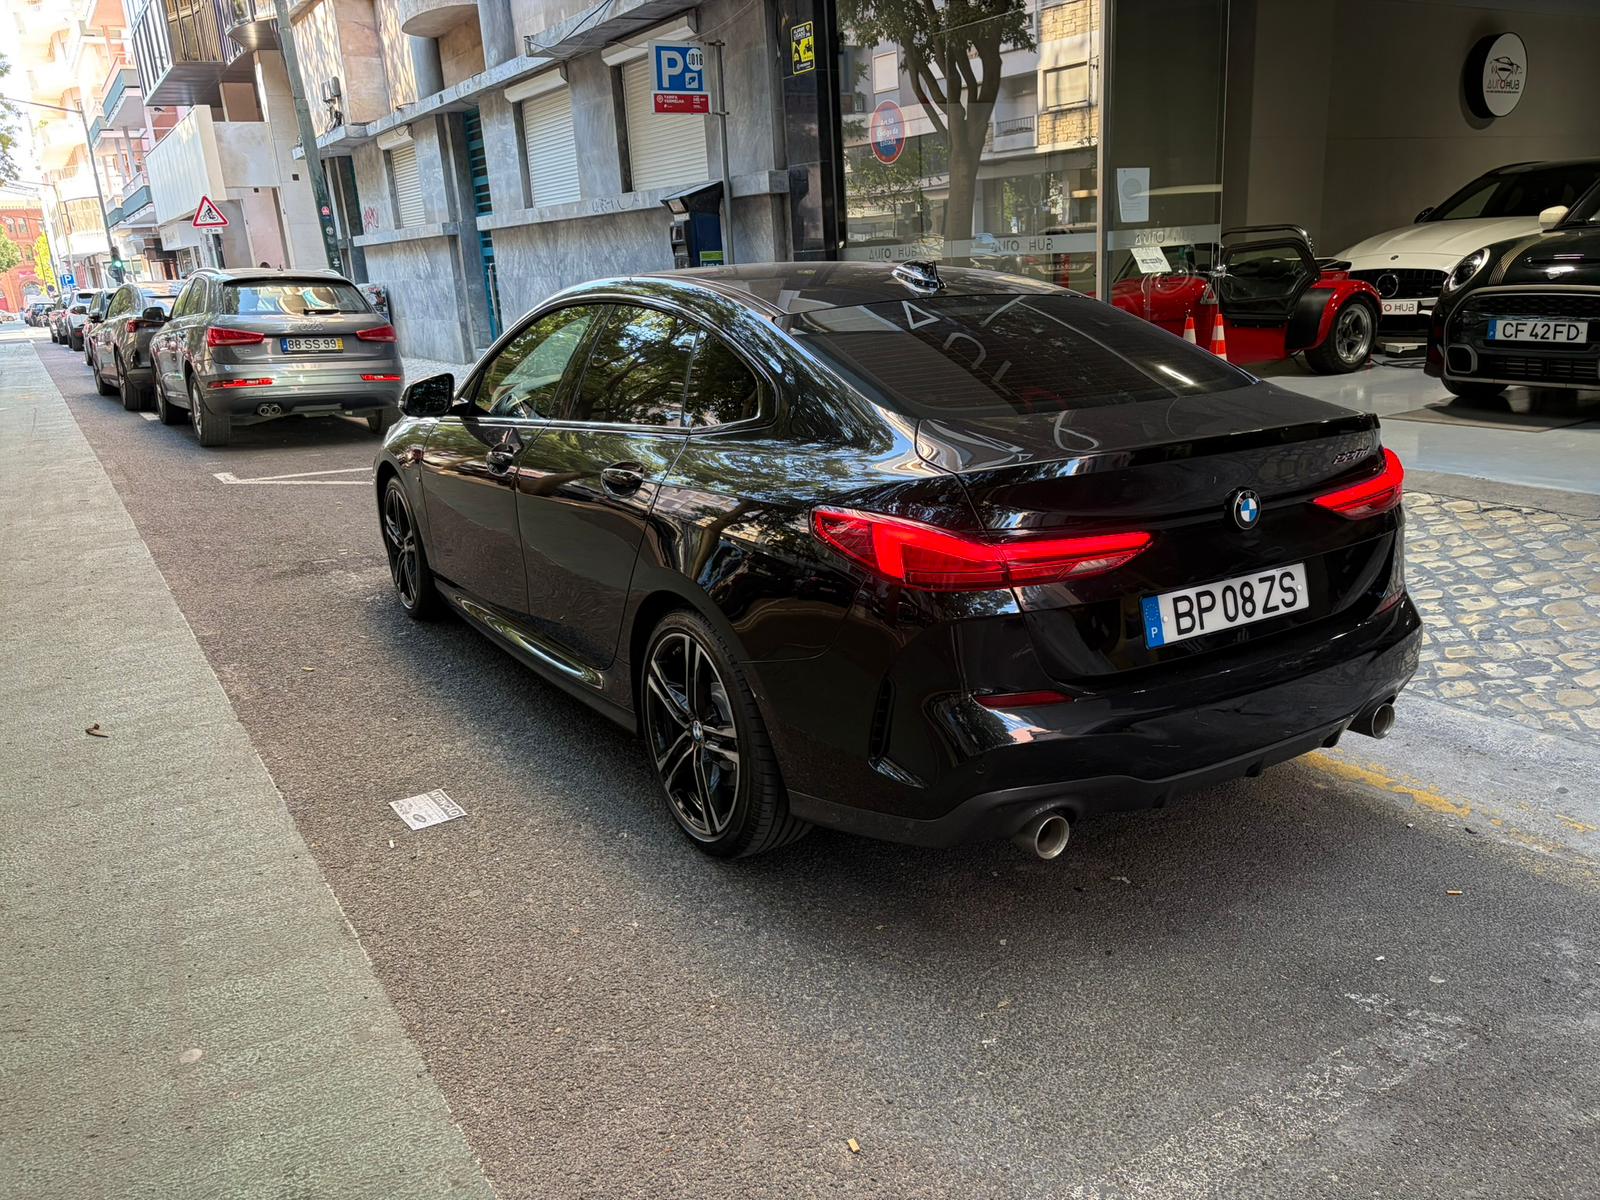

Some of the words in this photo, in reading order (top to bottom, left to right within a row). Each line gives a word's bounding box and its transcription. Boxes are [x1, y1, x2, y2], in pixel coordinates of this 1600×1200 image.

[661, 50, 684, 88] P
[1029, 238, 1054, 251] HUB
[869, 247, 892, 260] AUTO
[1394, 303, 1415, 312] HUB
